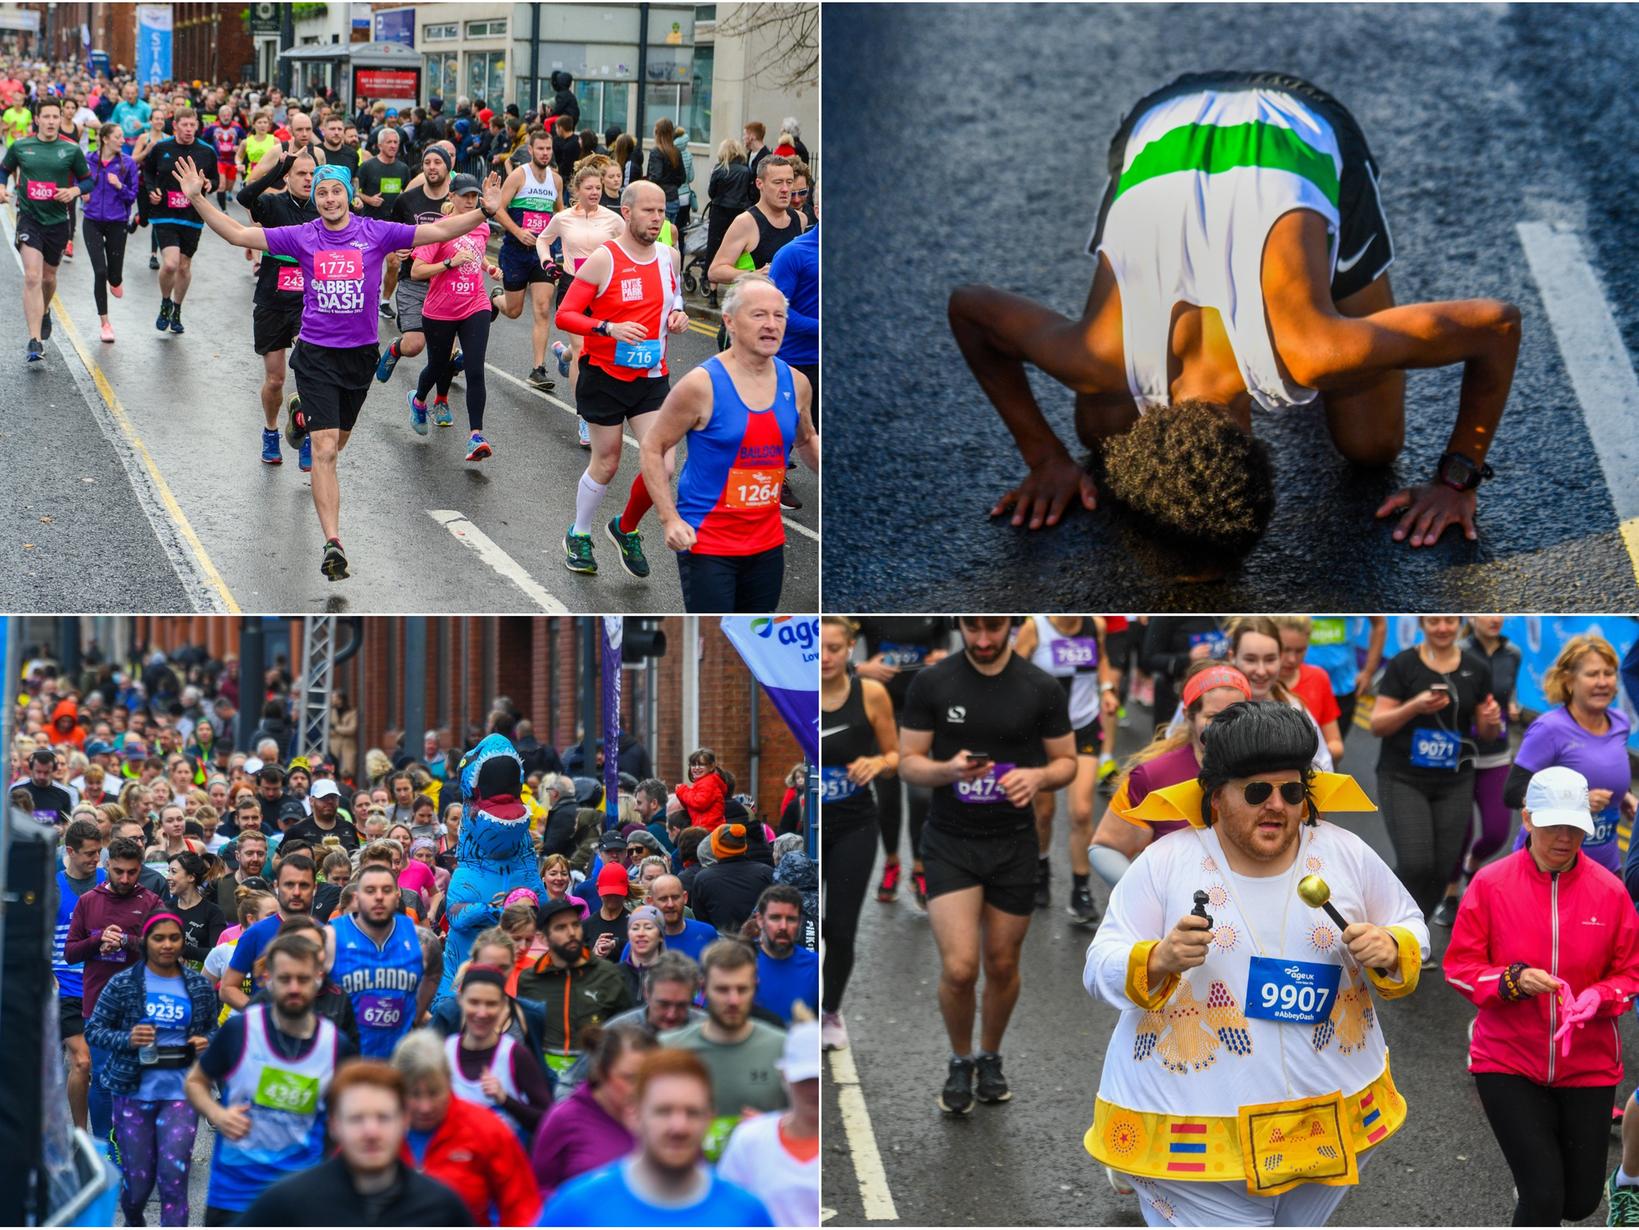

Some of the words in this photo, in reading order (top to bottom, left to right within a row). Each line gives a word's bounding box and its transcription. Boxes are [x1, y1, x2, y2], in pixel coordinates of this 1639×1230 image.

[30, 187, 53, 198] 2403
[528, 188, 553, 197] JASON
[527, 219, 548, 228] 2581
[320, 261, 355, 275] 1775
[317, 280, 364, 294] ABBEY
[451, 281, 475, 292] 1991
[317, 293, 365, 310] DASH
[627, 351, 652, 364] 716
[738, 482, 779, 502] 1264
[1418, 741, 1454, 756] 9071
[342, 968, 418, 994] ORLANDO
[1261, 982, 1330, 1013] 9907
[146, 1003, 184, 1020] 9235
[364, 1007, 400, 1023] 6760
[1274, 1010, 1315, 1021] #AbbeyDash
